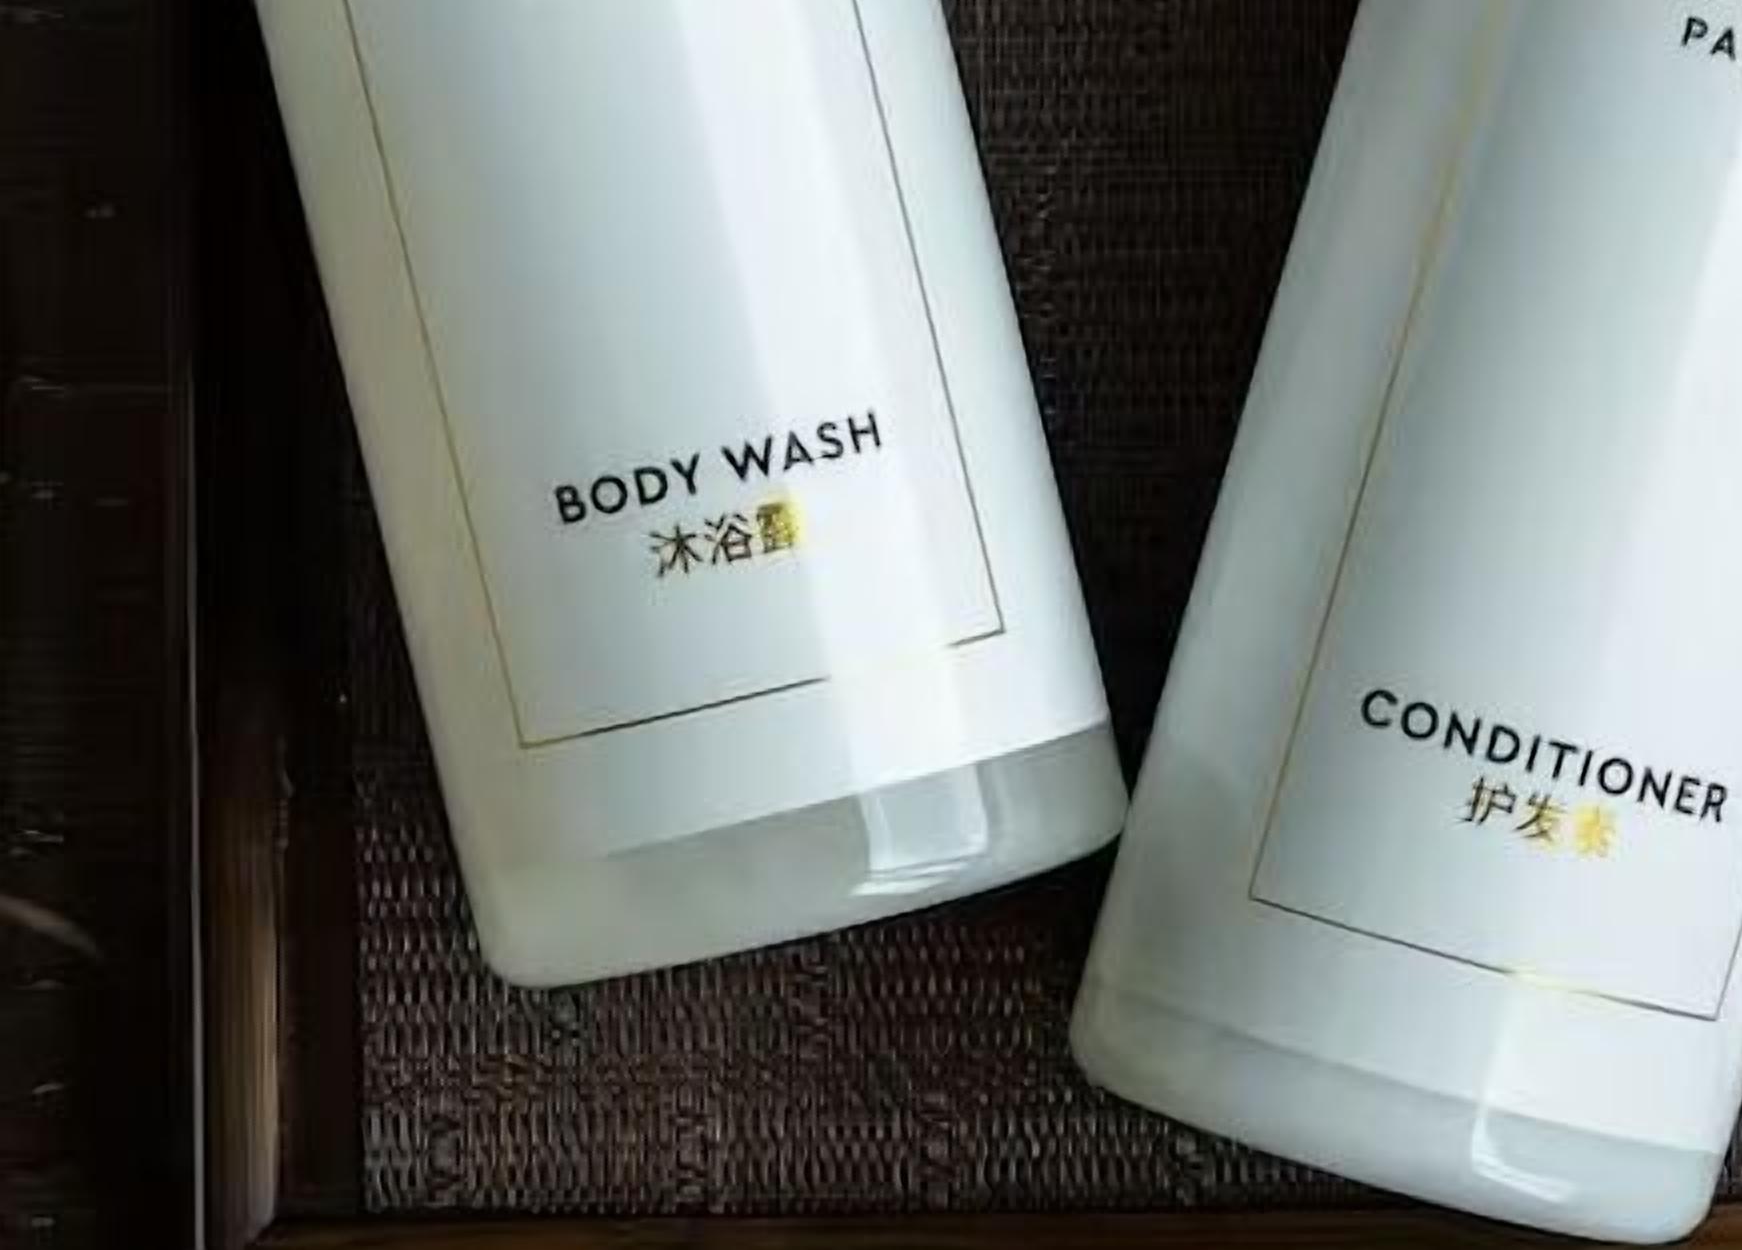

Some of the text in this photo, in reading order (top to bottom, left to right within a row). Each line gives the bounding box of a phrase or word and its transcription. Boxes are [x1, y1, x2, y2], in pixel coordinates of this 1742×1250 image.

[554, 410, 882, 525] BODY WASH
[1361, 689, 1729, 823] CONDITIONER
